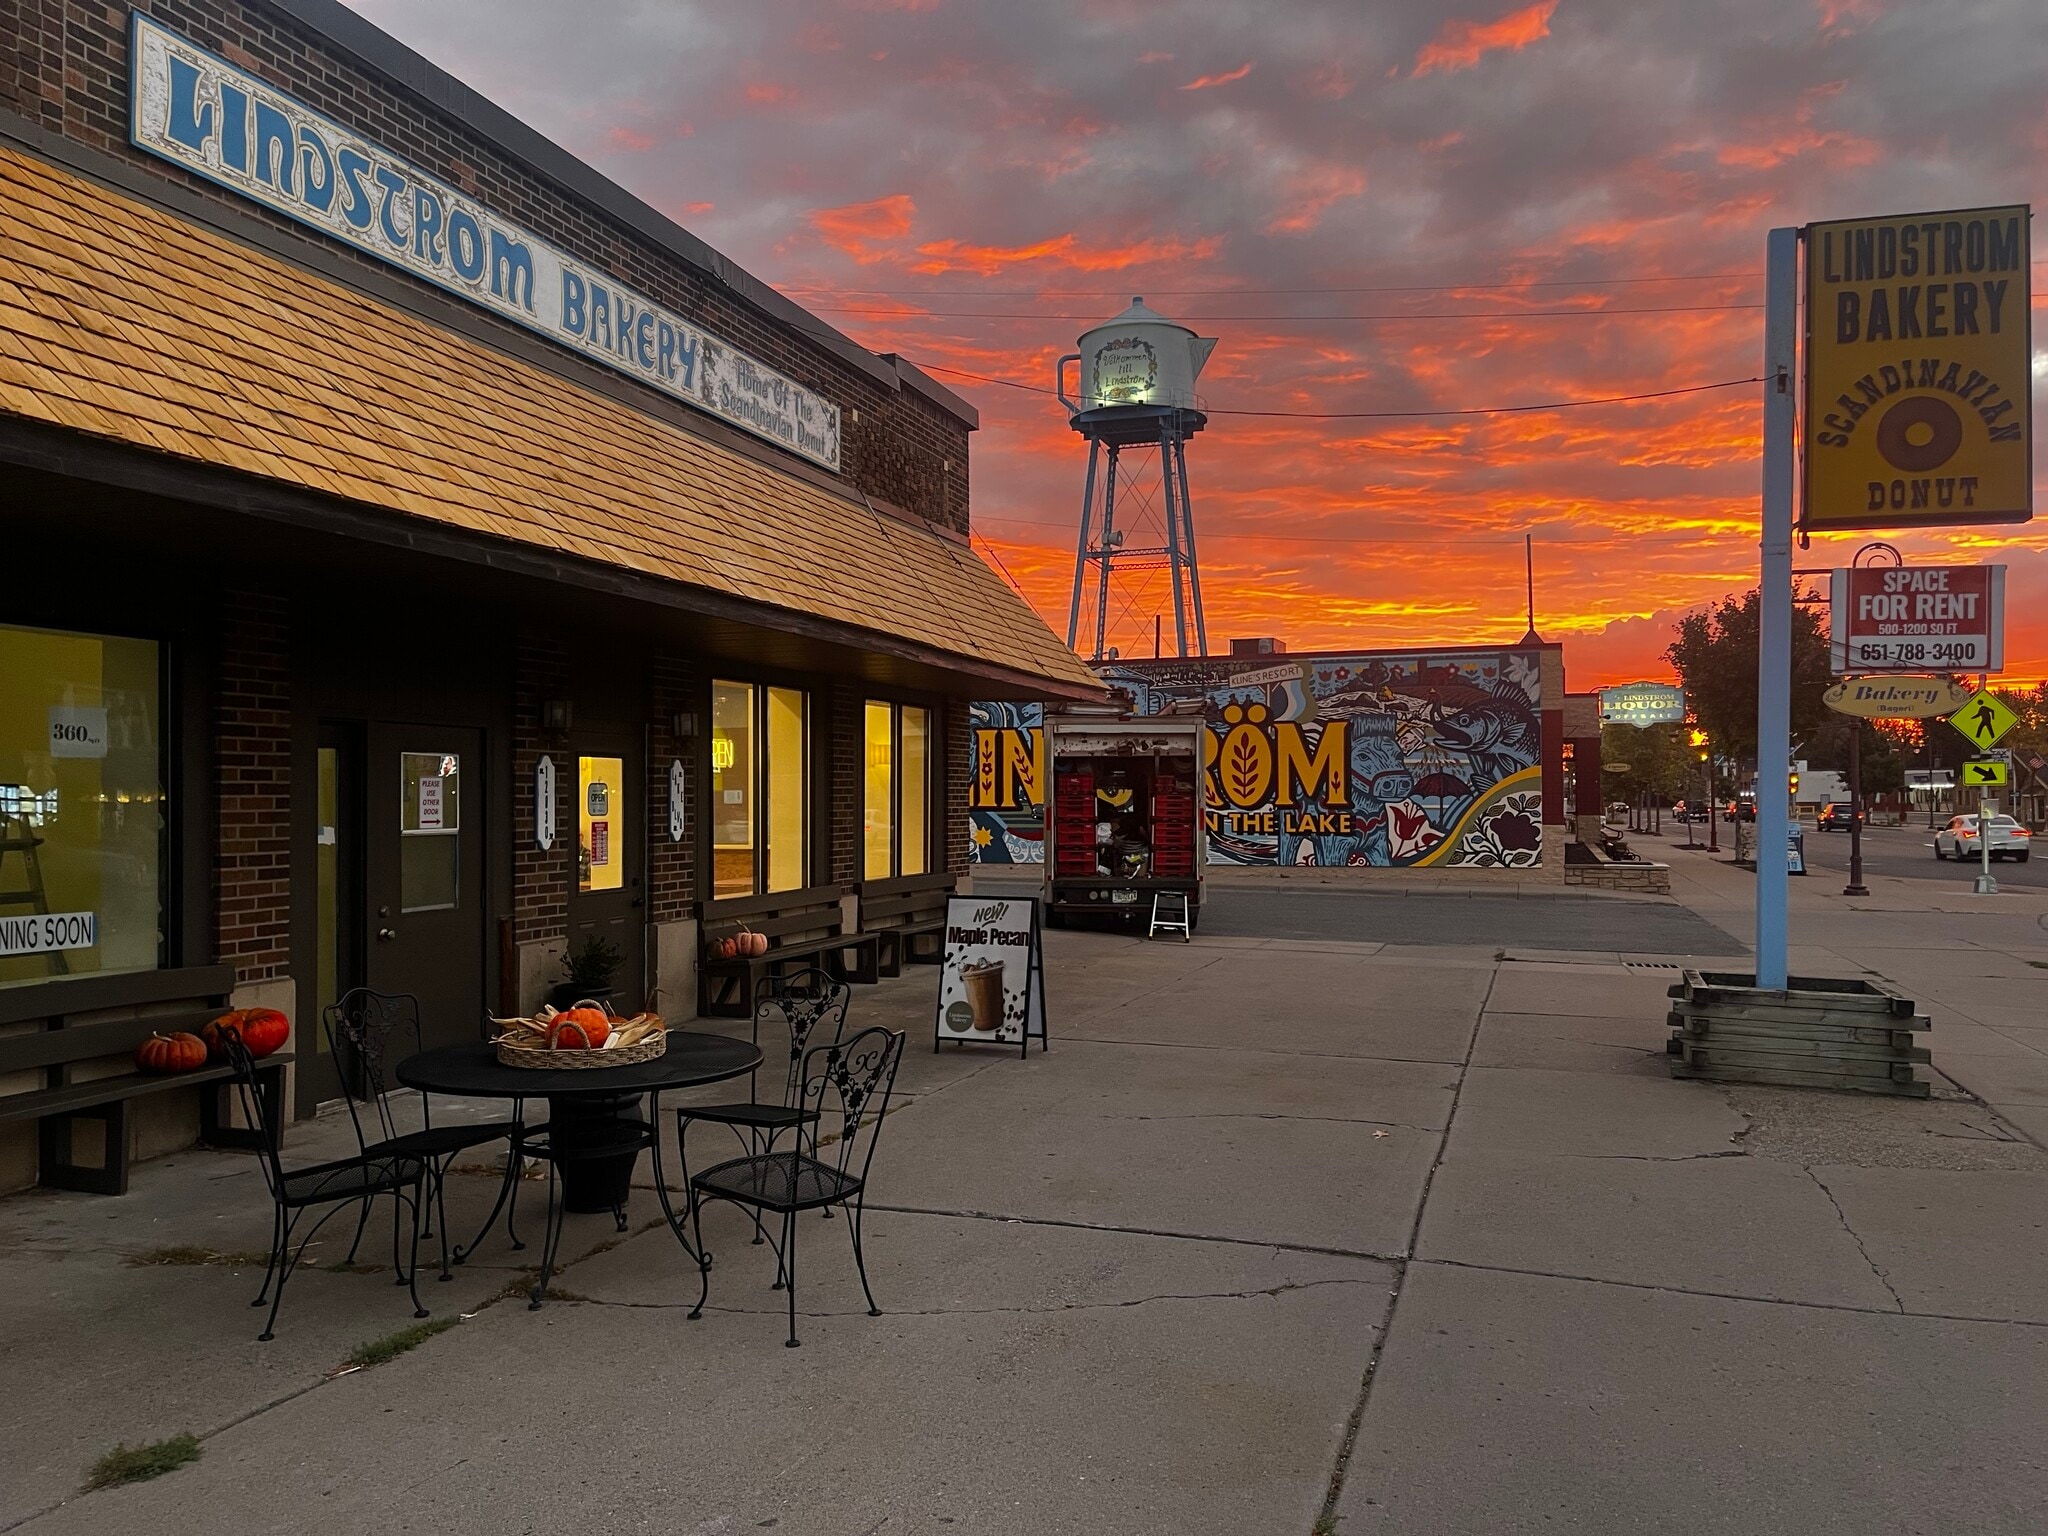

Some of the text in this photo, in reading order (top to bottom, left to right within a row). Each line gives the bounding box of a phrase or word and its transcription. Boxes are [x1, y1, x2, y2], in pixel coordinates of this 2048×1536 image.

[164, 51, 698, 391] LINDSTROM BAKERY
[1824, 217, 2019, 344] LINDSTROM BAKERY
[736, 361, 812, 421] Home Of The
[1817, 358, 2022, 448] SCANDINAVIAN
[721, 382, 825, 456] Scandinavian Donut
[1868, 476, 1978, 511] DONUT
[1883, 571, 1950, 593] SPACE
[1859, 593, 1979, 621] FOR RENT
[1878, 623, 1958, 635] 500-1200 SQ FT
[1860, 643, 1976, 661] 651-788-3400
[1231, 666, 1299, 686] KLINE'S RESORT
[1855, 685, 1939, 704] Bakery
[1603, 700, 1682, 711] LIQUOR
[53, 723, 88, 742] 360
[422, 780, 440, 788] PLEASE
[426, 789, 436, 797] USE
[1229, 813, 1274, 832] THE
[1285, 813, 1351, 833] LAKE
[44, 915, 92, 946] SOON
[948, 926, 1030, 947] Maple Pecan
